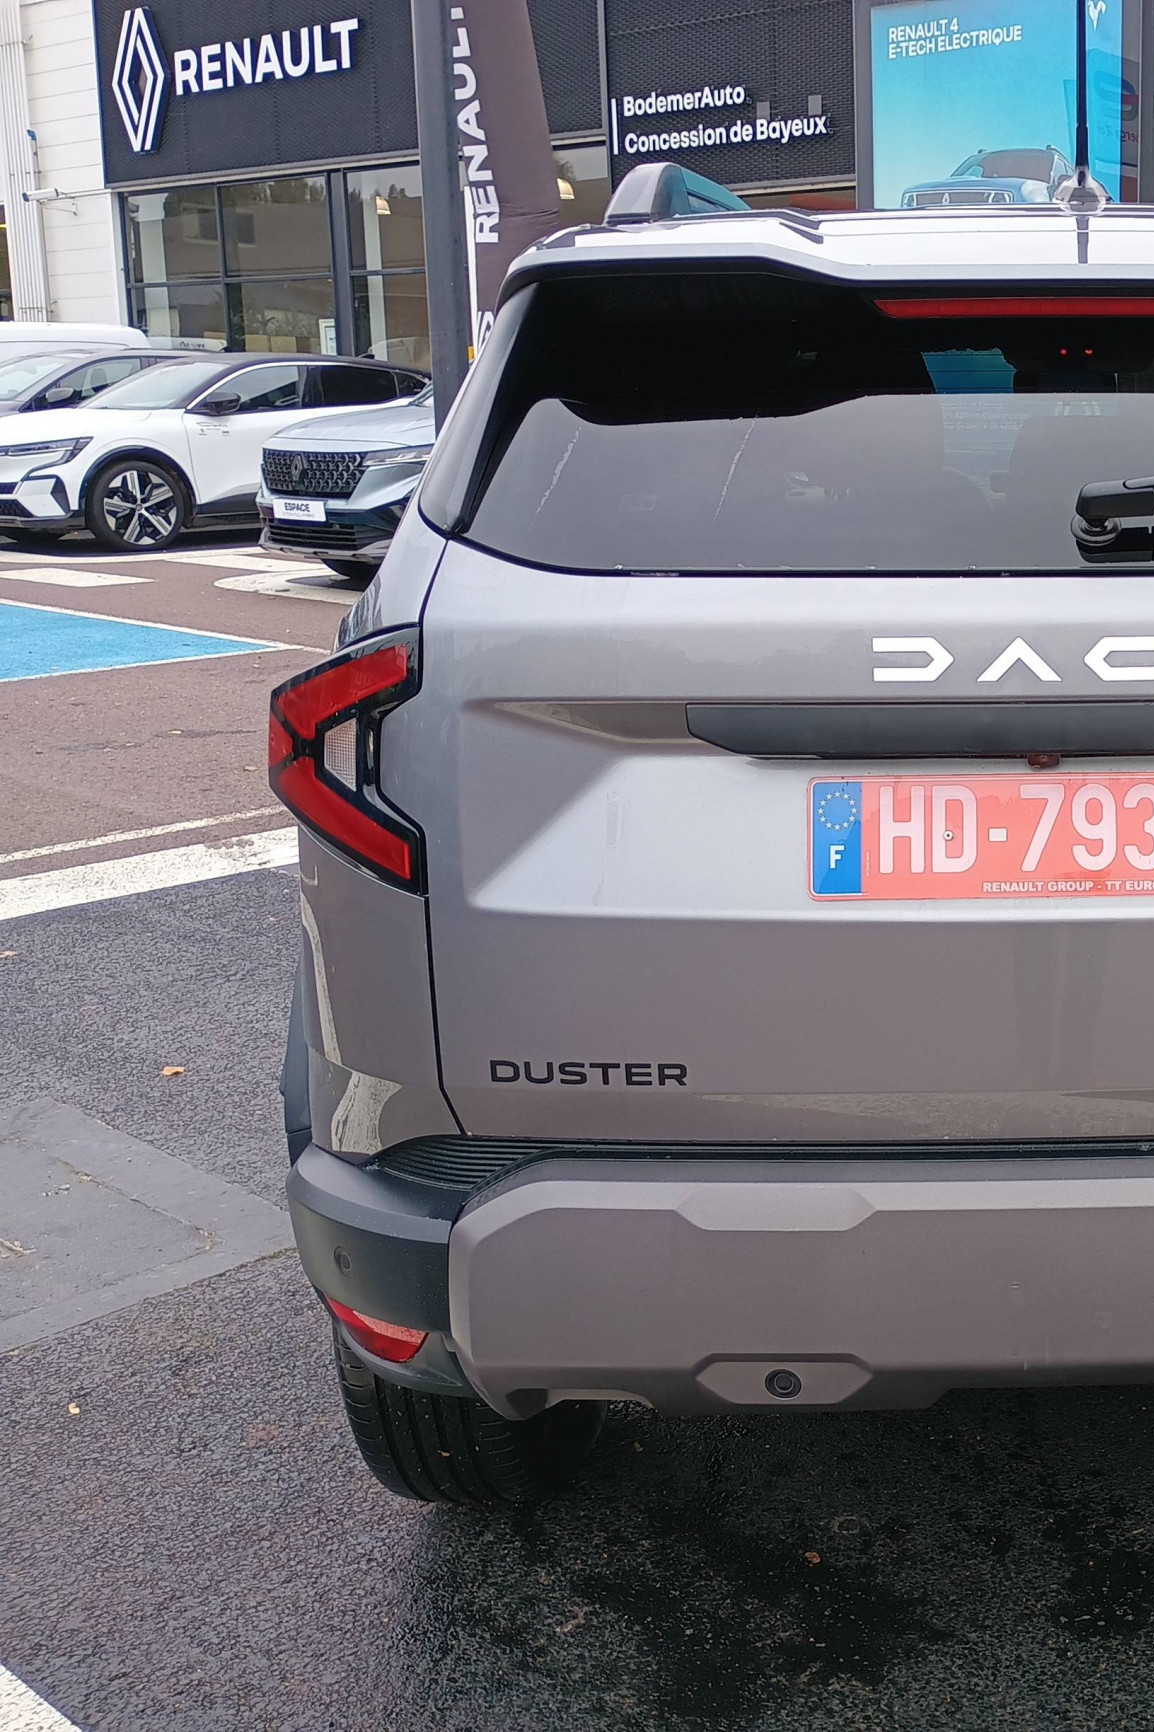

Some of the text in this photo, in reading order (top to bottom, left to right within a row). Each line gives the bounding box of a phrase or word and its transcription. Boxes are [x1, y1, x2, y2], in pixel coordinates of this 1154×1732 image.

[888, 17, 960, 43] RENAULT 4
[888, 24, 1023, 59] E-TECH ELECTRIQUE
[173, 17, 359, 96] RENAULT
[622, 86, 746, 117] BodemerAuto
[624, 115, 828, 154] Concession de Bayeux
[284, 502, 311, 513] ESPACE
[828, 844, 846, 870] F
[982, 881, 1045, 893] RENAULT
[1047, 880, 1095, 892] GROUP
[1104, 880, 1123, 892] TT
[488, 1059, 689, 1087] DUSTER
